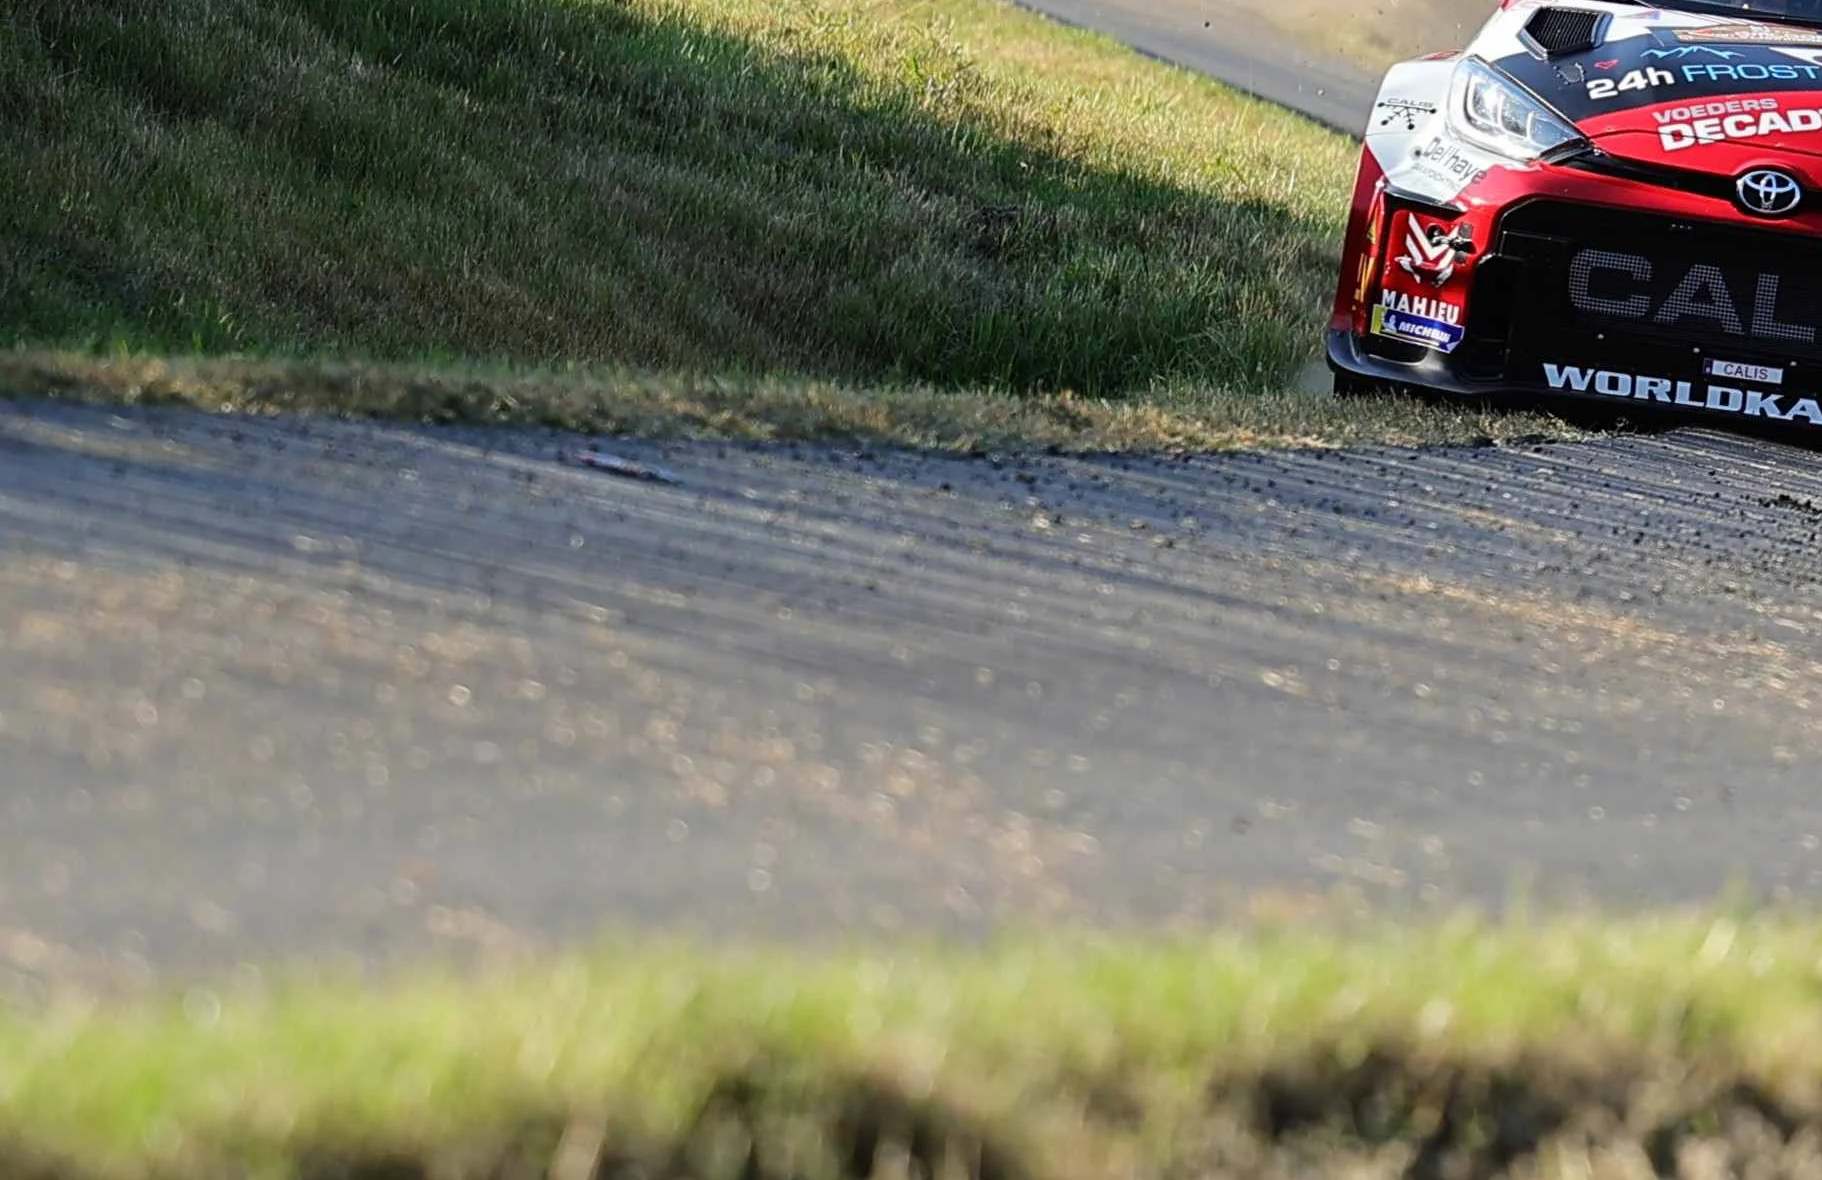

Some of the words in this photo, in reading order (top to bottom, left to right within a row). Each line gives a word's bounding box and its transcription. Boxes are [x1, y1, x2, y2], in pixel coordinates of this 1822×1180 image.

[1586, 67, 1675, 100] 24h
[1681, 64, 1820, 83] FROST
[1652, 98, 1778, 123] VOEDERS
[1381, 289, 1459, 325] MAHIEU
[1723, 363, 1768, 380] CALIS
